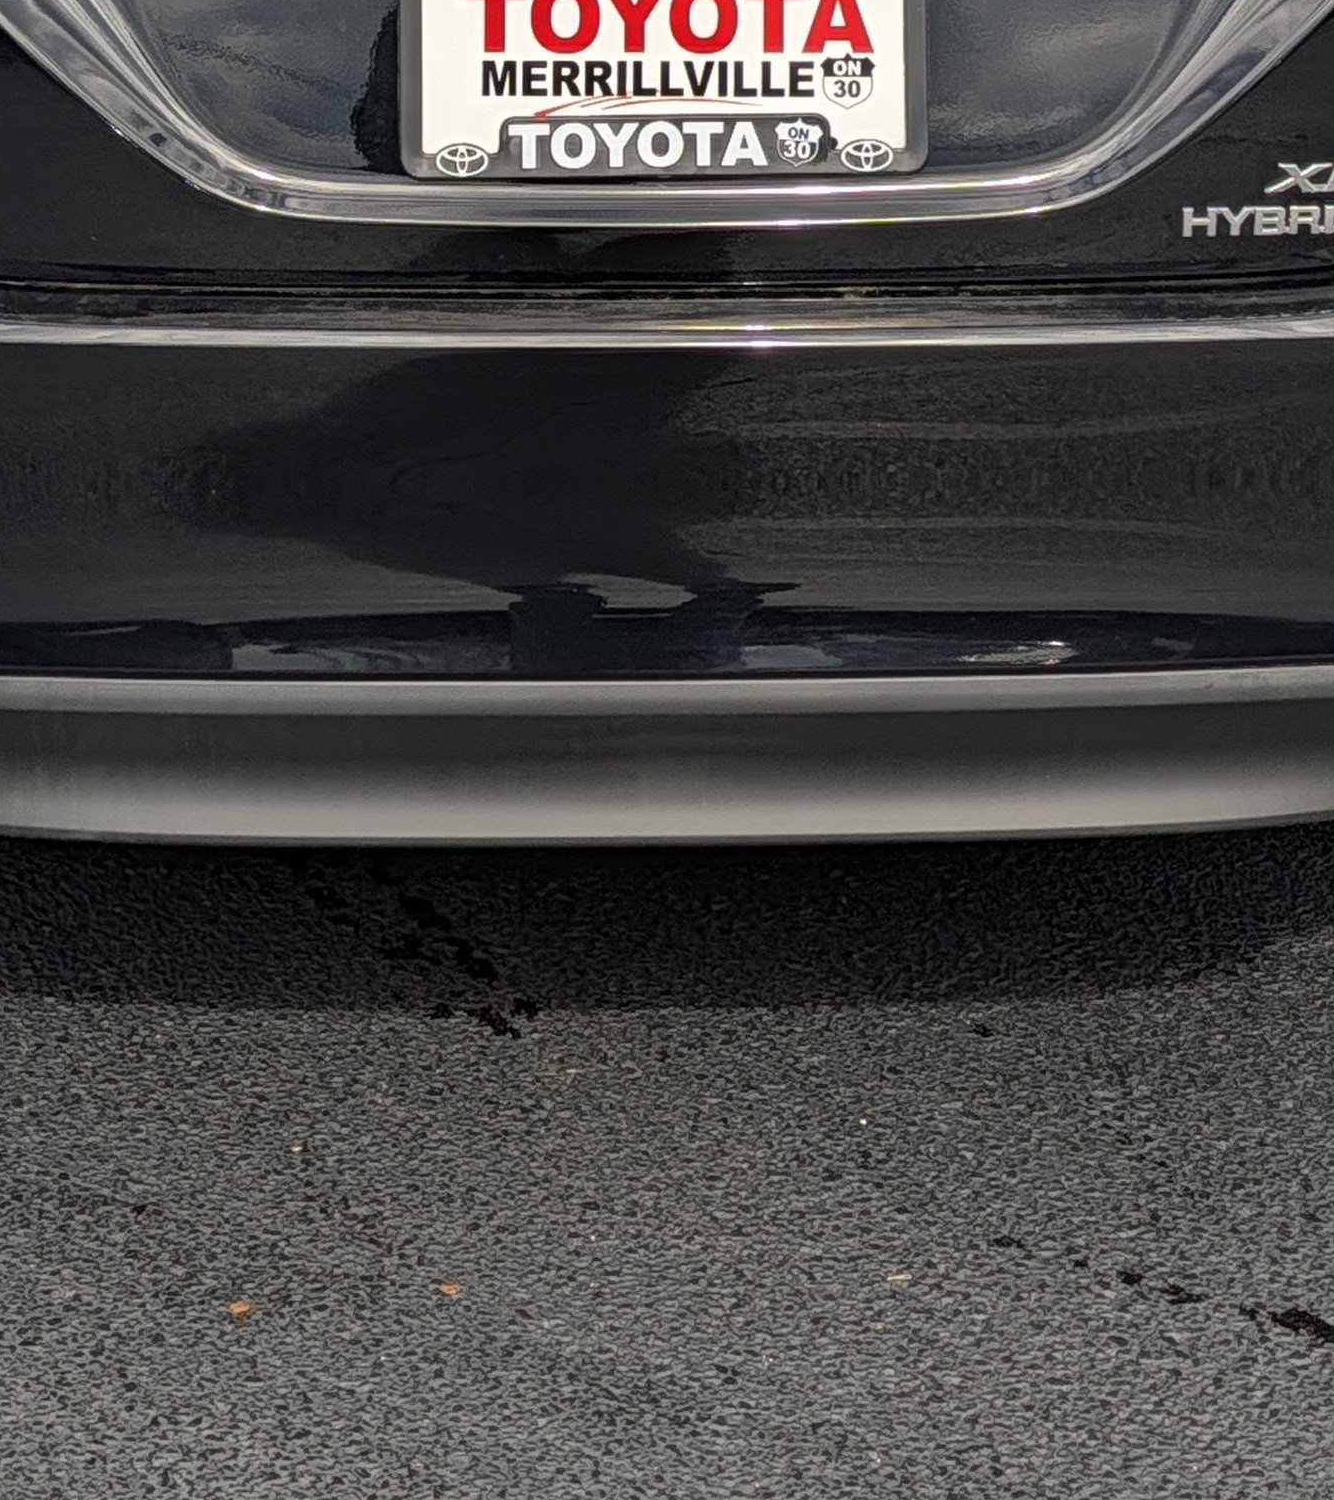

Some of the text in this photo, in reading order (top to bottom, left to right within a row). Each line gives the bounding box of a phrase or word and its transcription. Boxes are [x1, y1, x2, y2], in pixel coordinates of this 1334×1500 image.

[832, 59, 863, 77] ON
[481, 60, 816, 98] MERRILLVILLE
[833, 79, 862, 98] 30
[788, 126, 810, 140] ON
[507, 120, 769, 169] TOYOTA
[782, 139, 811, 160] 30
